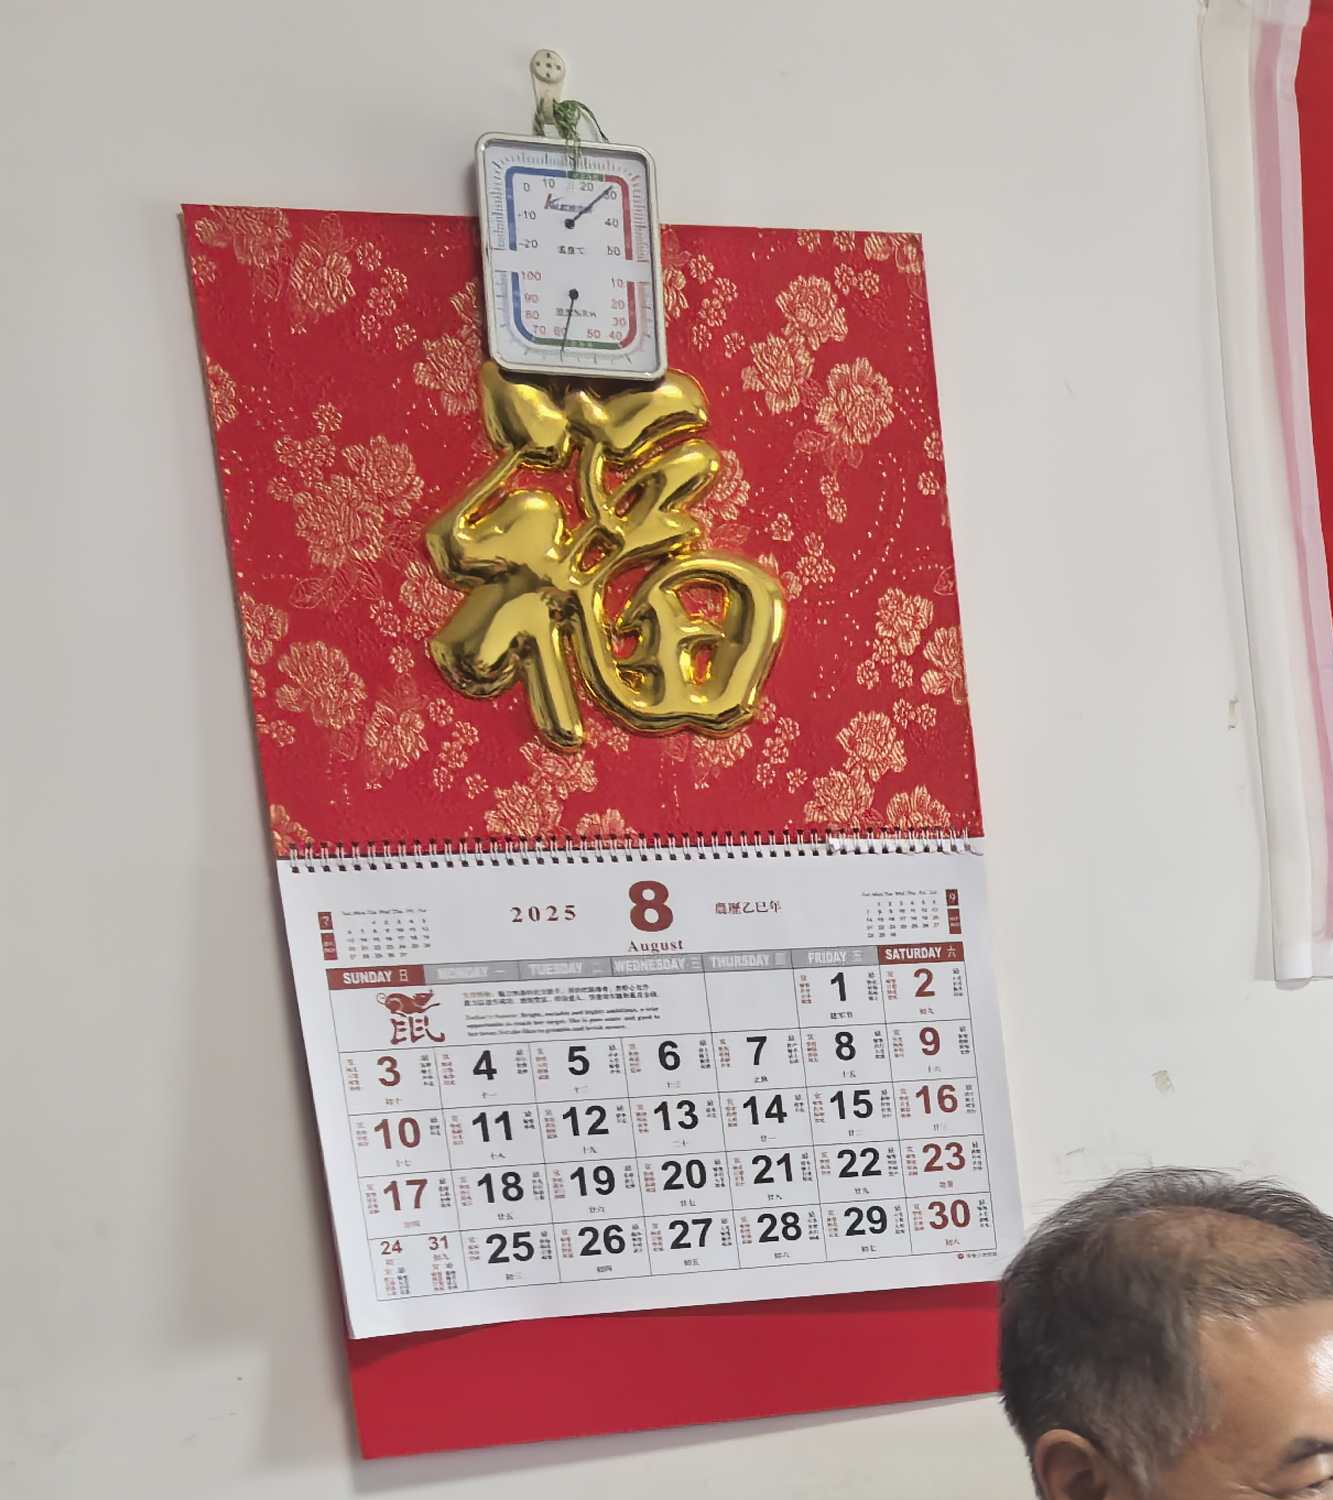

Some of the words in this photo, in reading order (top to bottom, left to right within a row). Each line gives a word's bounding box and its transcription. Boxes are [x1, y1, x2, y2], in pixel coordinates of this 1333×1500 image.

[522, 181, 531, 192] 0
[542, 179, 556, 189] 10
[579, 182, 594, 192] 20
[605, 219, 619, 228] 40
[521, 271, 542, 281] 100
[611, 279, 624, 289] 10
[611, 300, 625, 310] 20
[613, 317, 626, 327] 30
[533, 326, 546, 336] 70
[587, 330, 600, 340] 50
[609, 331, 623, 341] 40
[512, 905, 576, 922] 2025
[629, 881, 673, 932] 8
[628, 939, 684, 954] August
[885, 947, 943, 961] SATURDAY
[614, 957, 686, 972] WEDNESDAY
[711, 953, 771, 969] THURSDAY
[807, 951, 848, 964] FRIDAY
[343, 970, 393, 985] SUNDAY
[831, 972, 846, 1001] 1
[914, 968, 935, 997] 2
[377, 1056, 400, 1086] 3
[473, 1050, 497, 1080] 4
[568, 1046, 589, 1075] 5
[659, 1041, 680, 1070] 6
[747, 1036, 767, 1065] 7
[835, 1032, 856, 1060] 8
[920, 1027, 940, 1055] 9
[374, 1117, 420, 1149] 10
[472, 1111, 512, 1142] 11
[563, 1106, 609, 1136] 12
[654, 1100, 698, 1130] 13
[743, 1095, 787, 1125] 14
[830, 1090, 873, 1119] 15
[916, 1085, 957, 1114] 16
[384, 1179, 427, 1210] 17
[478, 1172, 523, 1203] 18
[570, 1166, 615, 1196] 19
[662, 1160, 706, 1190] 20
[752, 1153, 792, 1184] 21
[838, 1148, 882, 1178] 22
[922, 1142, 965, 1172] 23
[381, 1240, 402, 1255] 24
[428, 1235, 449, 1250] 31
[486, 1231, 534, 1264] 25
[578, 1225, 625, 1256] 26
[669, 1218, 712, 1249] 27
[757, 1212, 802, 1242] 28
[844, 1206, 887, 1236] 29
[928, 1199, 970, 1229] 30
